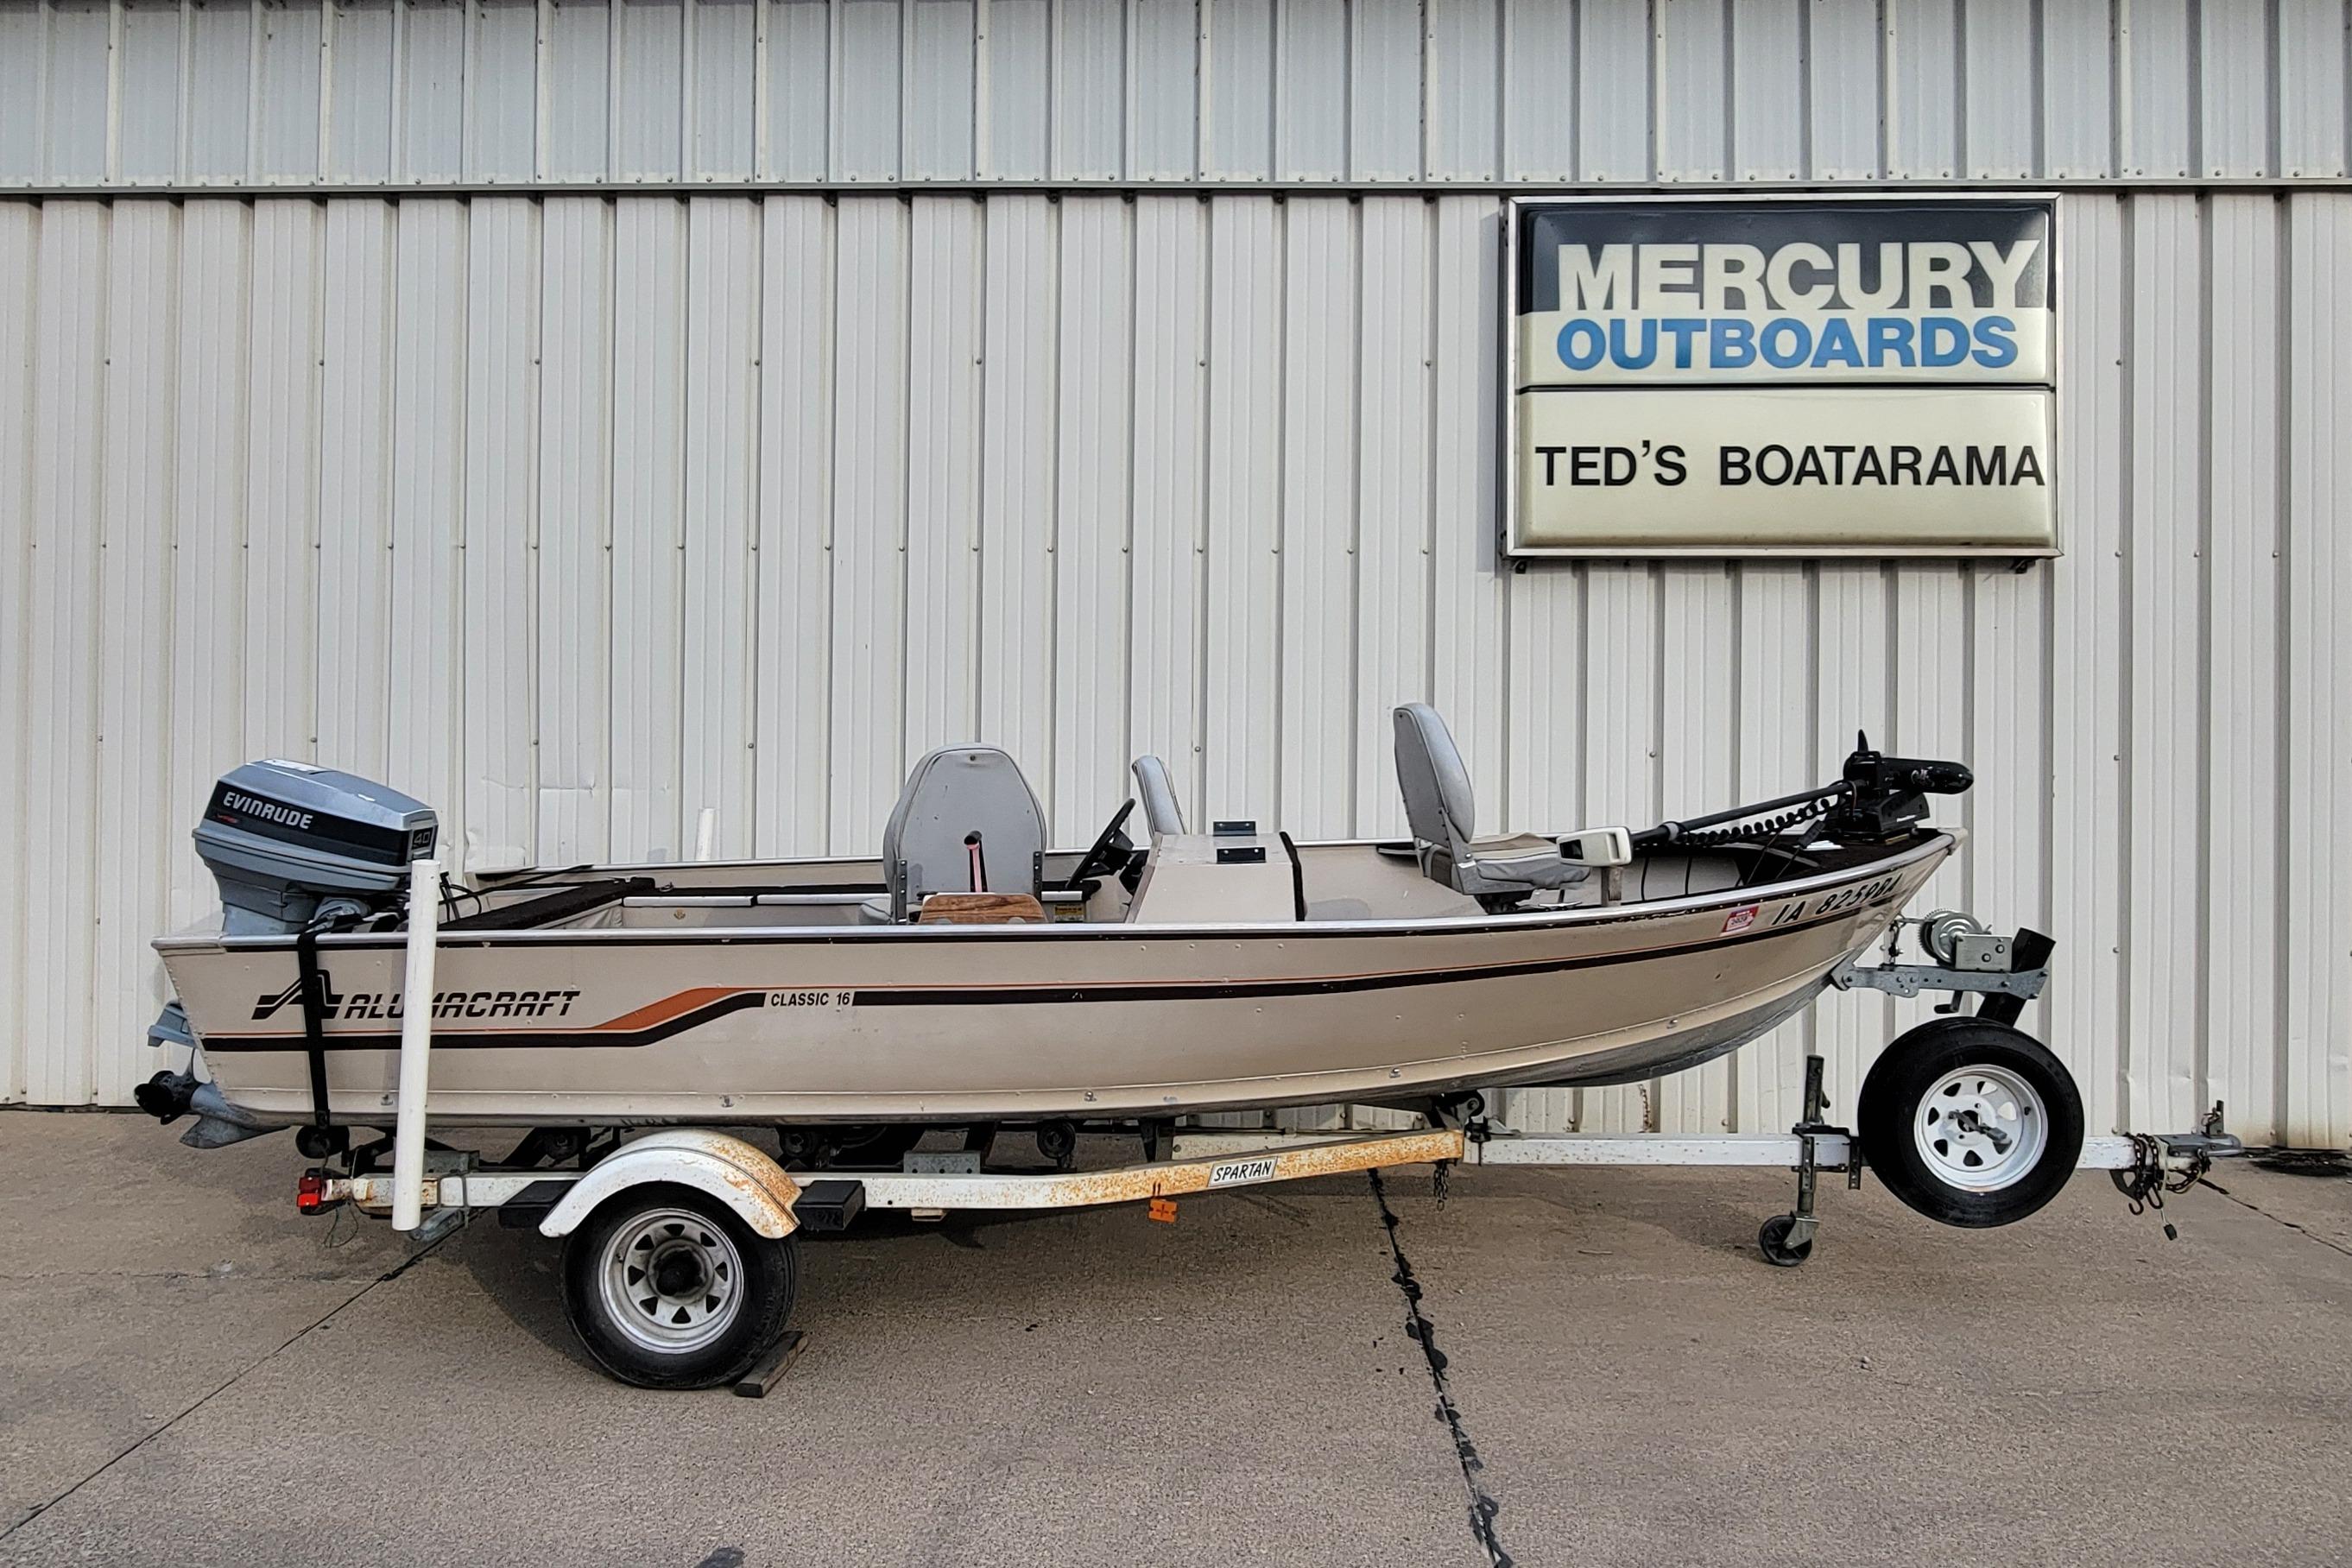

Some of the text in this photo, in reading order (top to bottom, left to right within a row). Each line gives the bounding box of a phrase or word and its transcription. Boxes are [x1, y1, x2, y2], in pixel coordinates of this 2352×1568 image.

[1558, 242, 2041, 311] MERCURY
[1557, 315, 2019, 370] OUTBOARDS
[1535, 439, 2045, 486] TED'S BOATARAMA
[223, 792, 314, 830] EVINRUDE
[414, 831, 431, 844] 40
[1771, 901, 1807, 926] IA
[771, 991, 850, 1007] CLASSIC 16
[1214, 1161, 1272, 1182] SPARTAN
